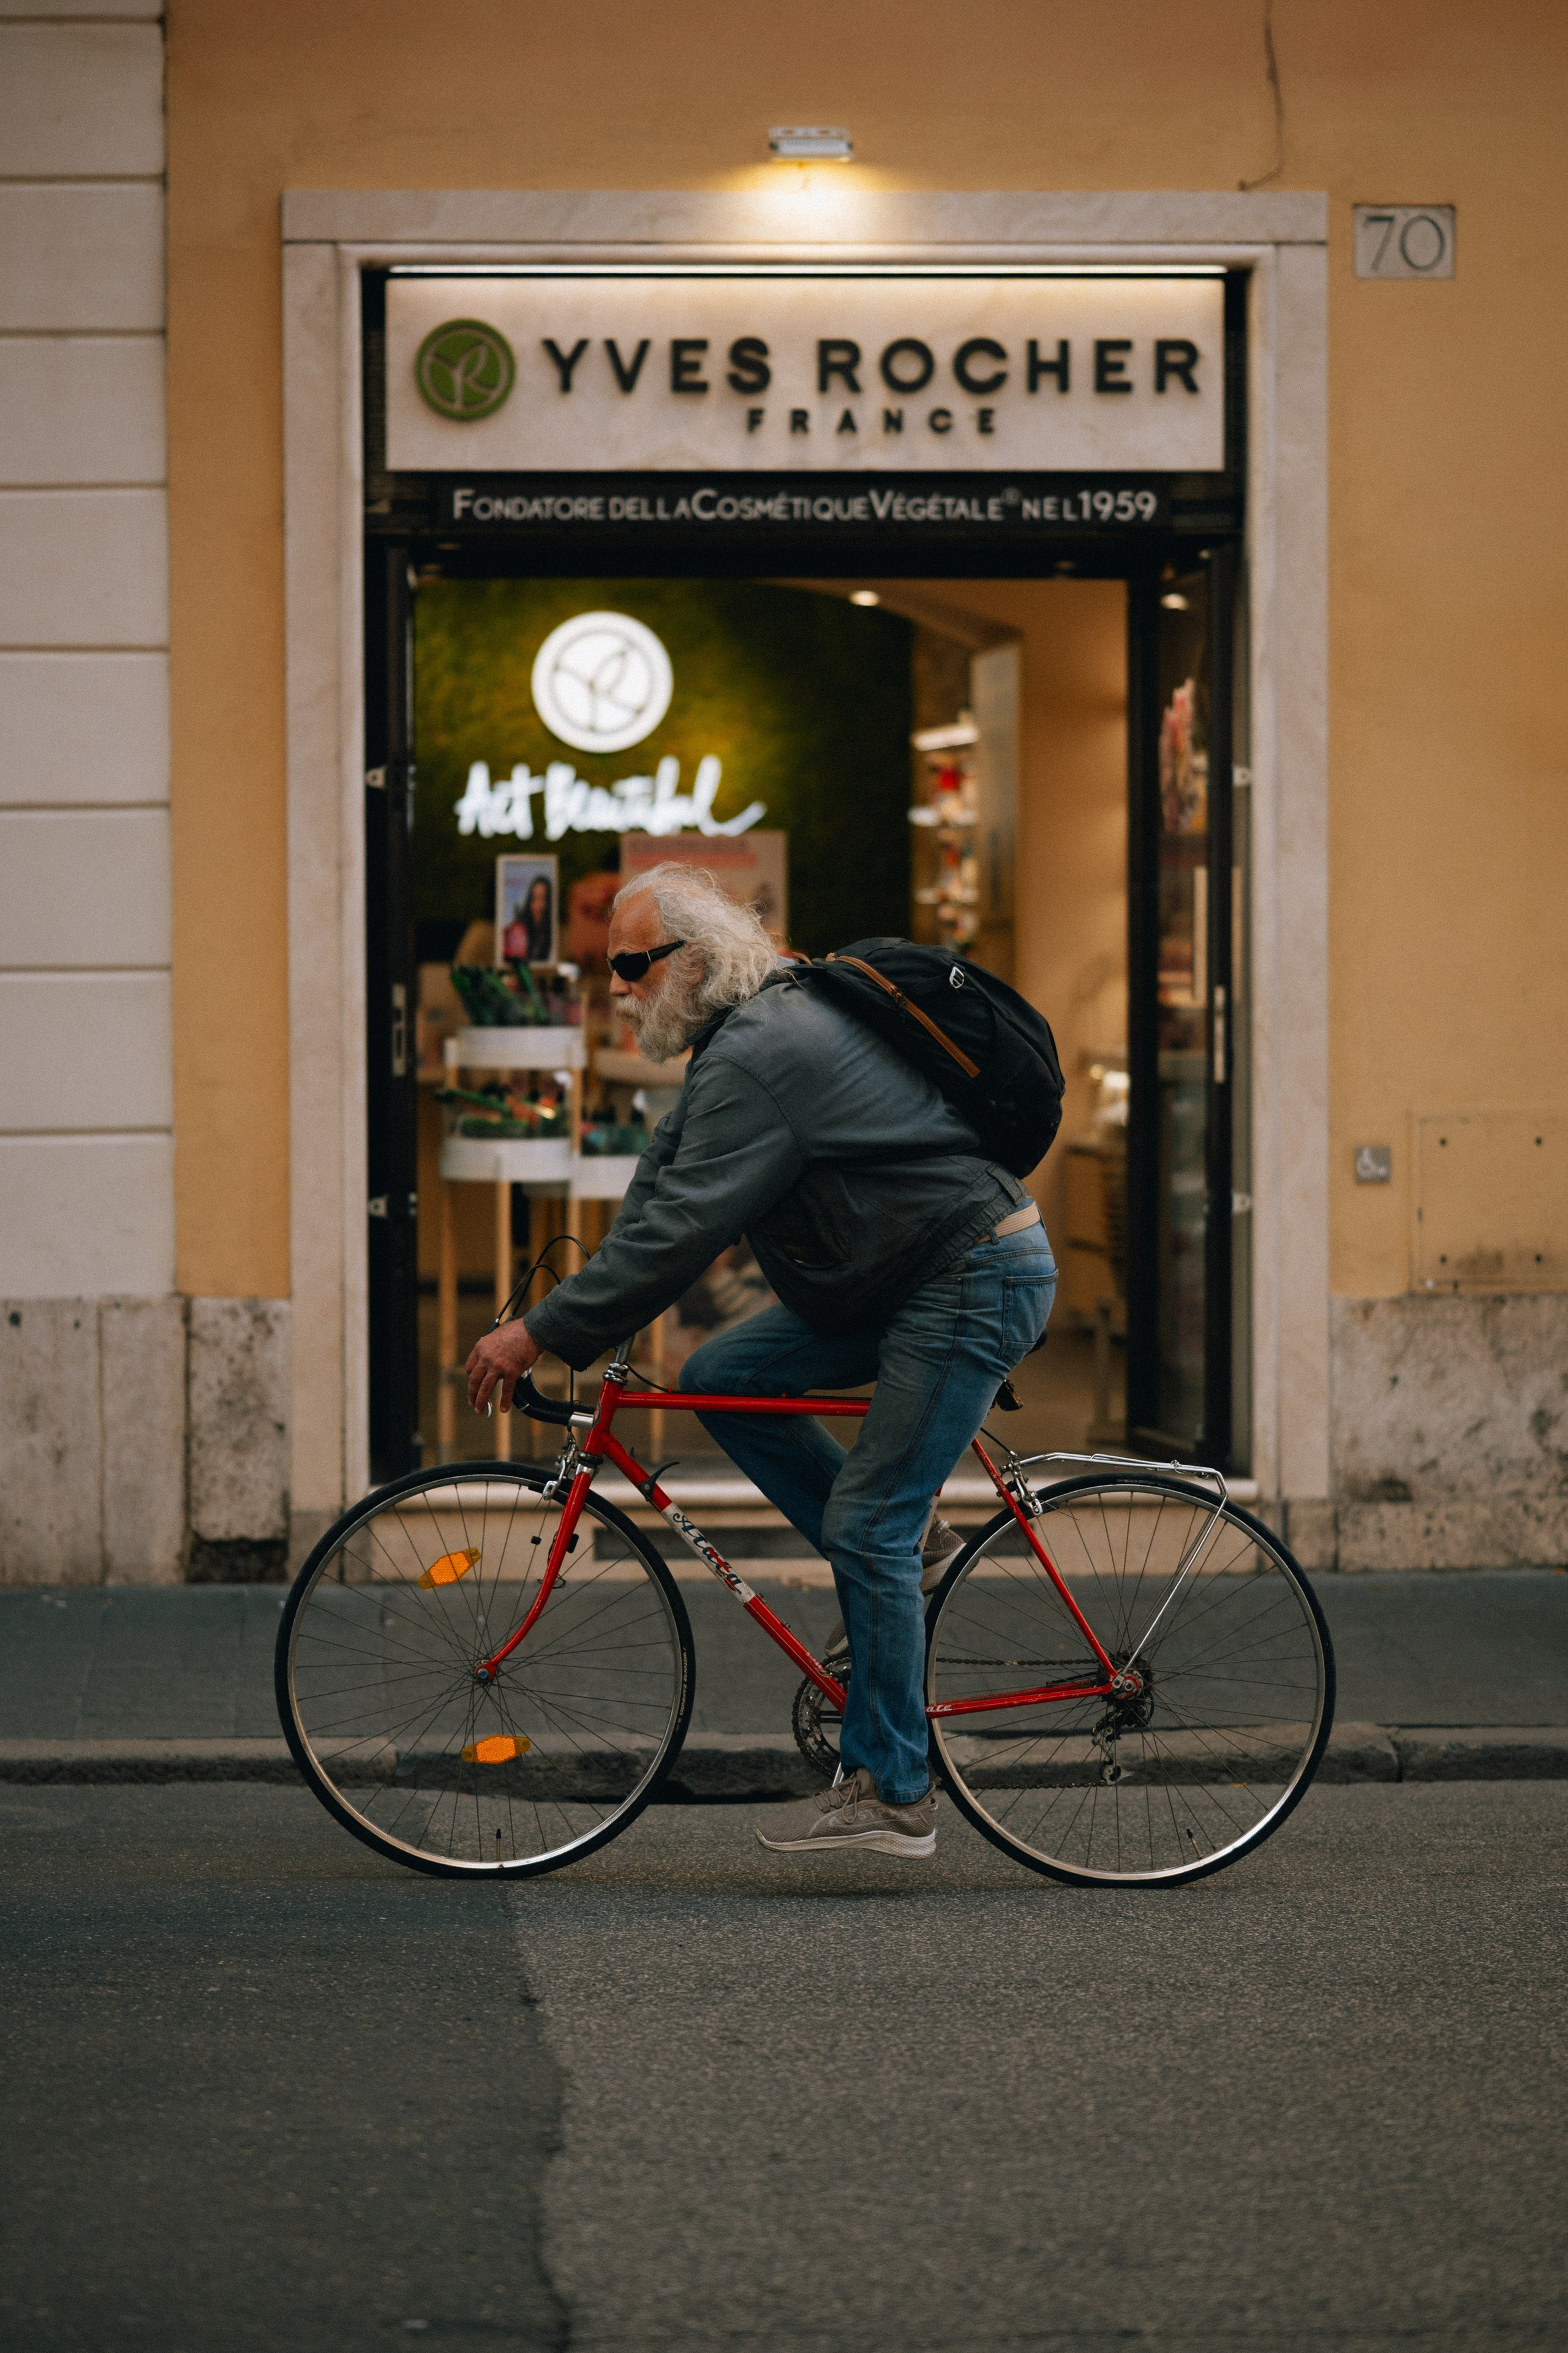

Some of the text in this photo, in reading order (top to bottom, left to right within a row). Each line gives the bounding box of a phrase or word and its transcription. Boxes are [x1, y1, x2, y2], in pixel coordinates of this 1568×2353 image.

[1362, 215, 1446, 271] 70
[540, 337, 1201, 395] YVES ROCHER
[745, 408, 995, 434] FRANCE
[453, 489, 605, 520] FONDATORE
[1021, 496, 1077, 520] NEL
[1077, 490, 1157, 521] 1959
